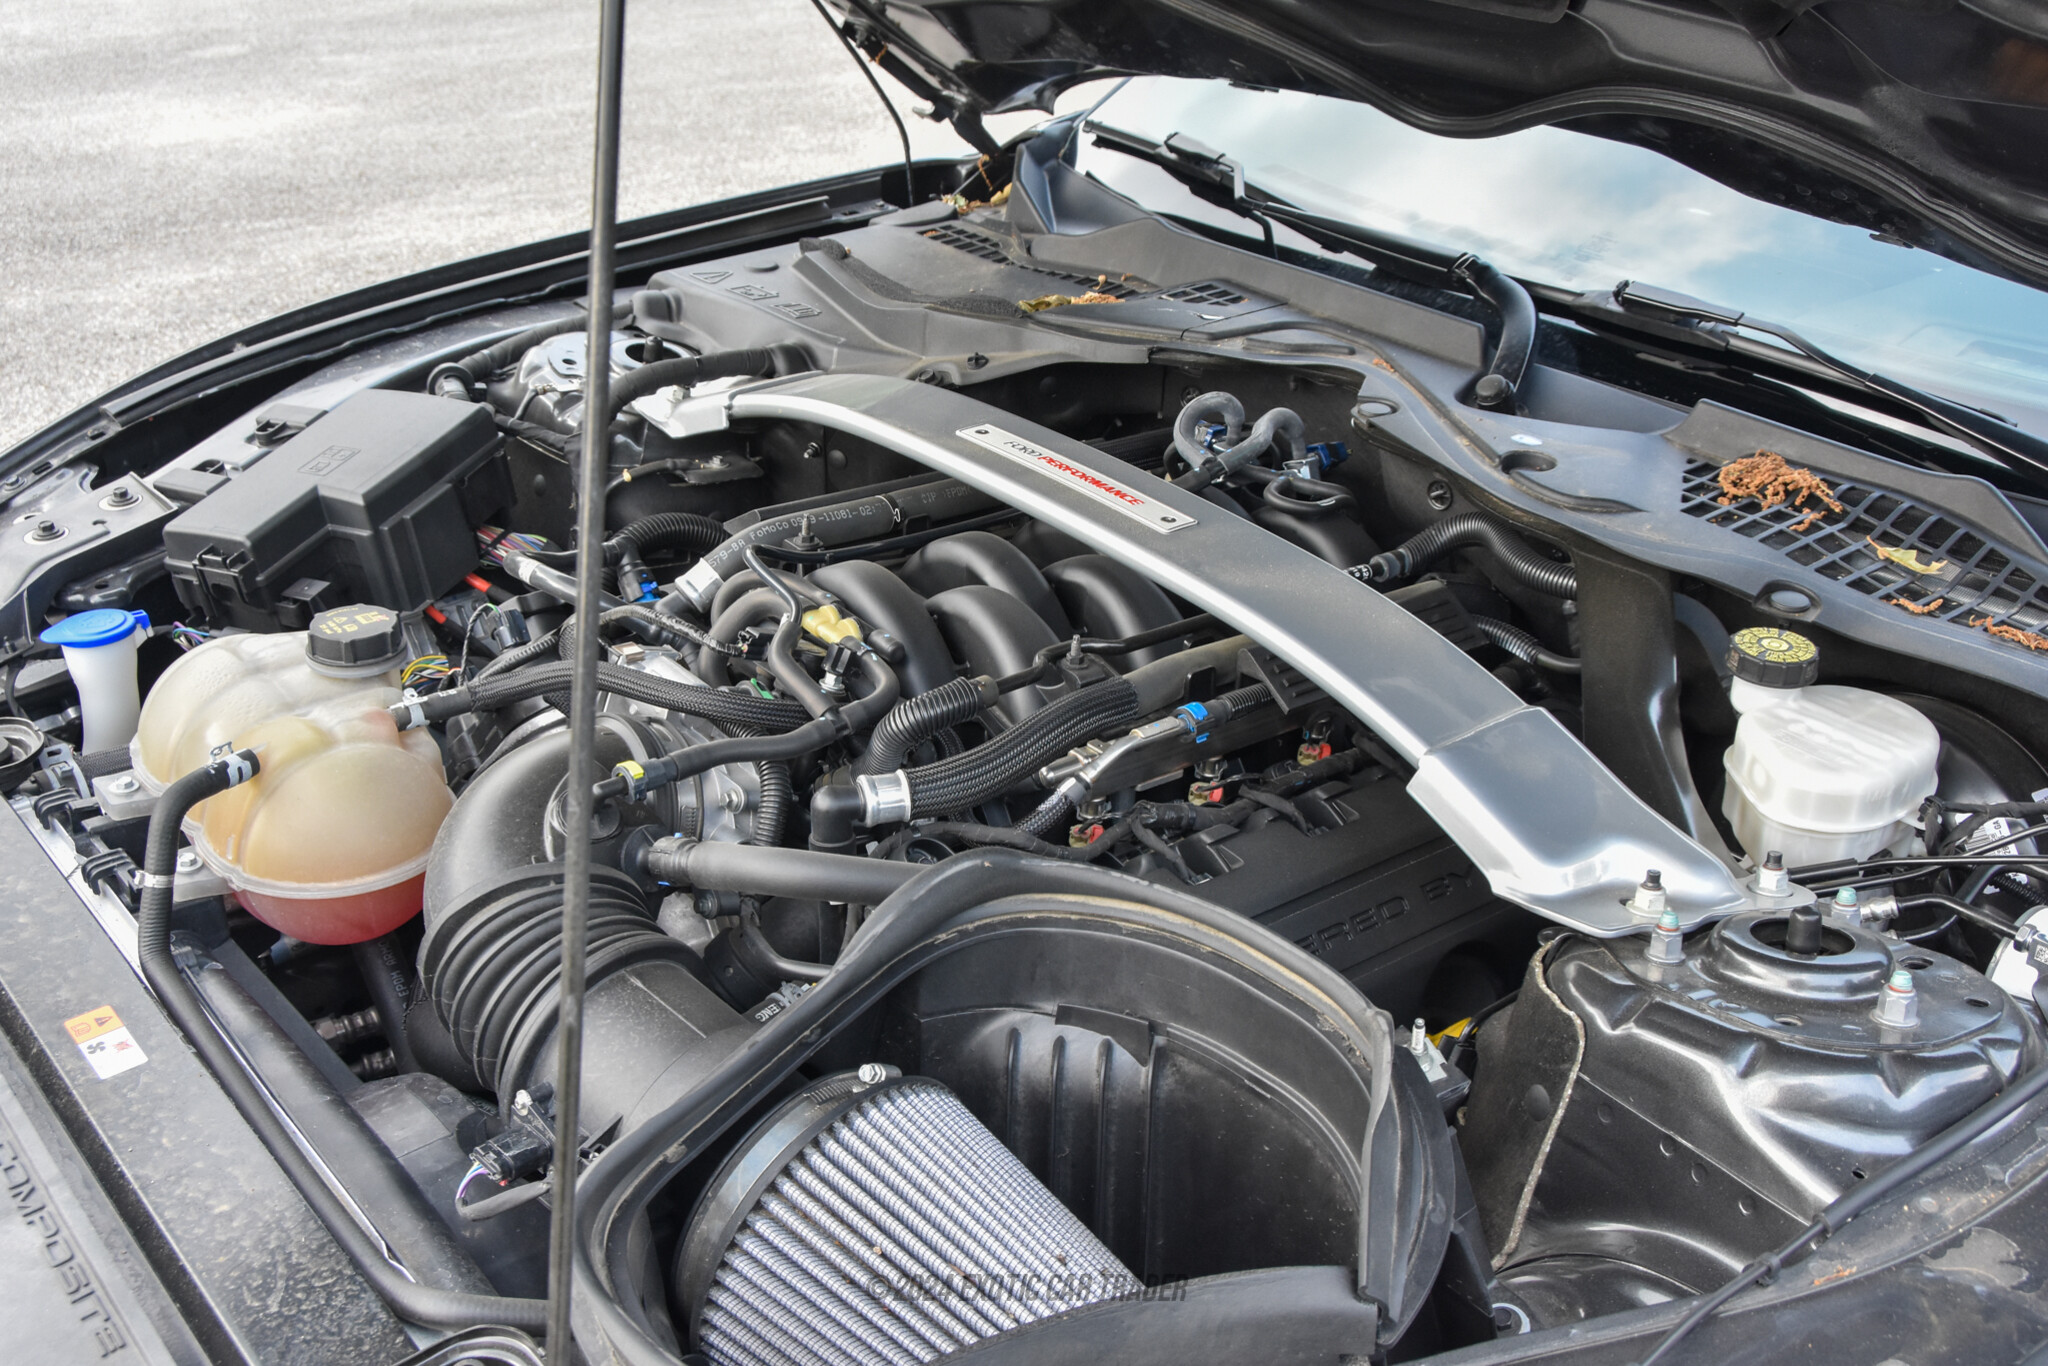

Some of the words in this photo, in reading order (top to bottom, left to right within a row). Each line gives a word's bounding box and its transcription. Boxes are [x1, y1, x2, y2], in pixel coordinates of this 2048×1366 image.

[1003, 440, 1043, 458] FORD
[1037, 454, 1145, 507] PERFORMANCE
[749, 521, 789, 541] FoMoCo
[0, 1142, 127, 1359] COMPOSITE
